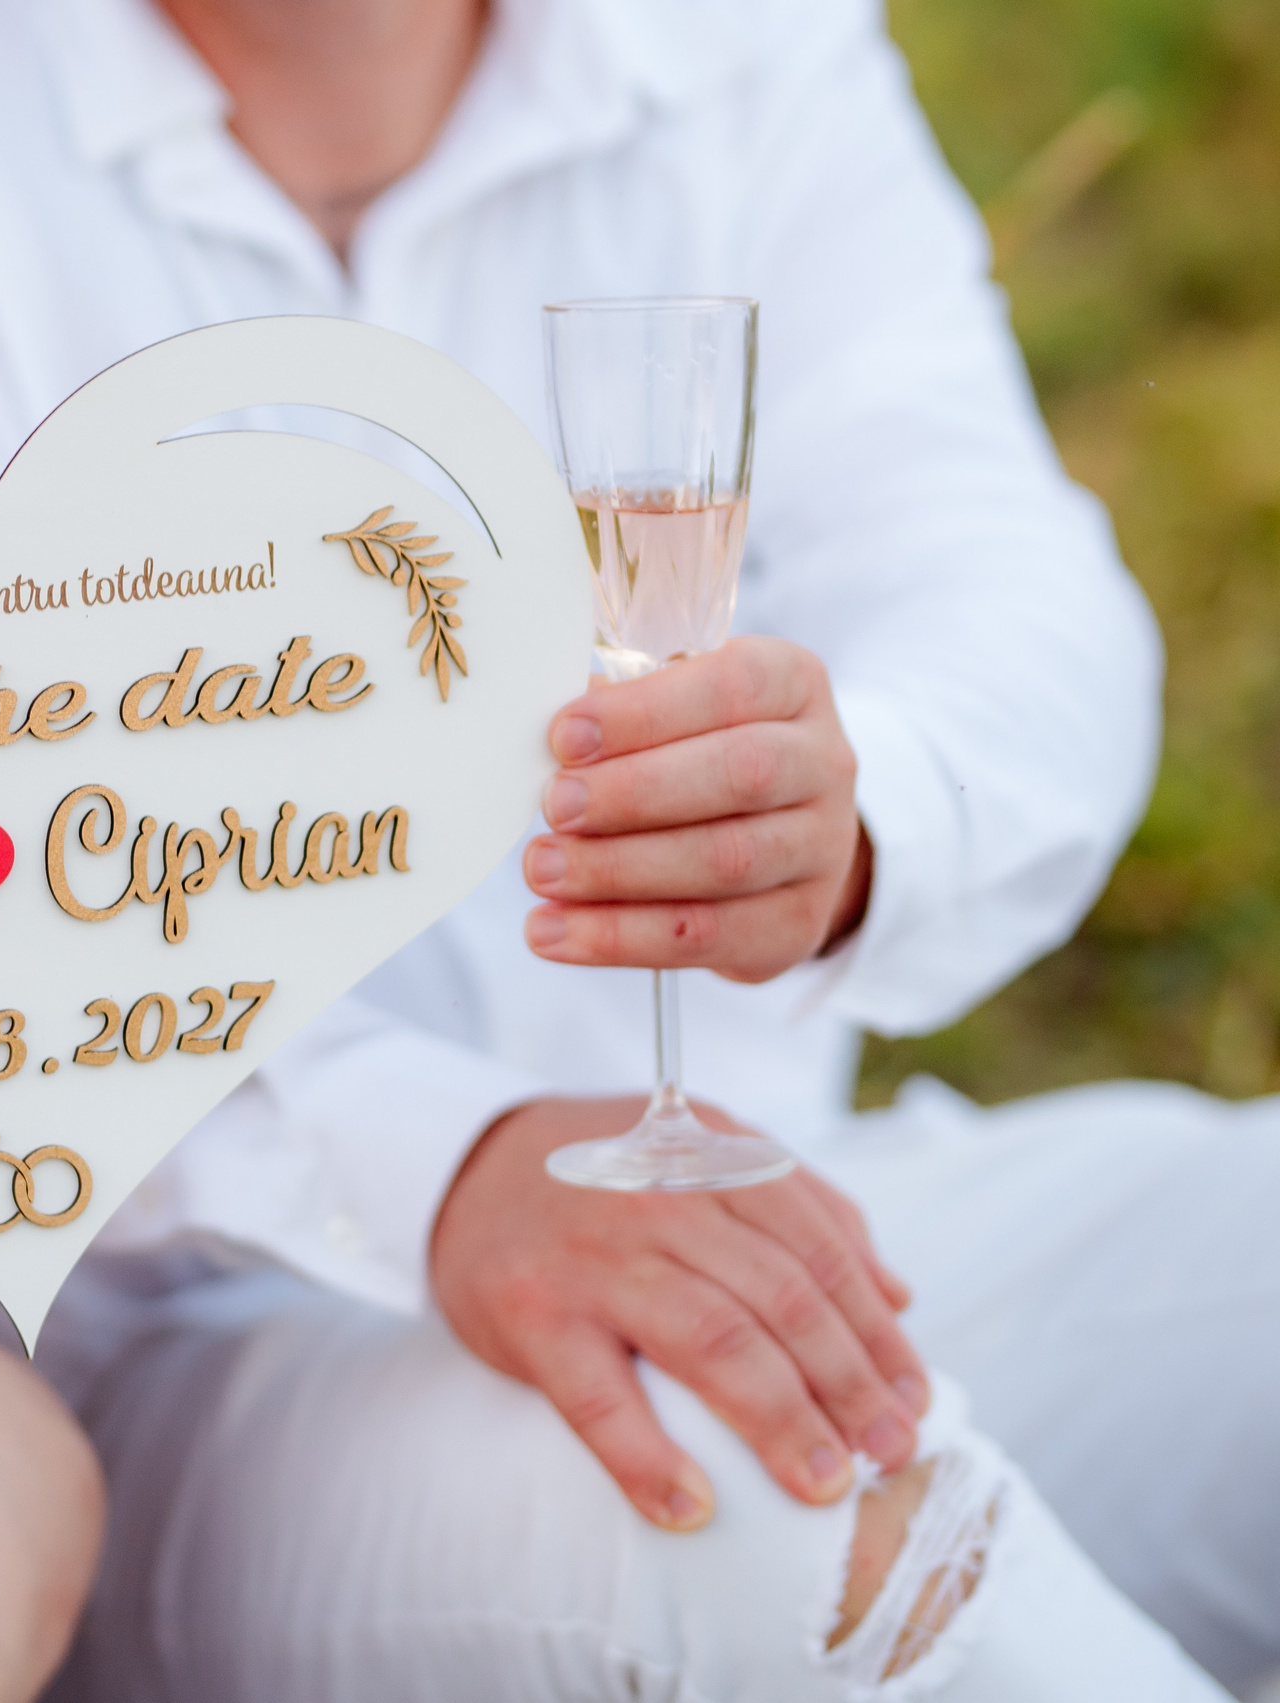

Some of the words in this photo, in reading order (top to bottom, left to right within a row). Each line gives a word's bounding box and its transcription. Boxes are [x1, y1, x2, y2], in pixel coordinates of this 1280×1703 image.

[79, 542, 277, 606] totdeauna!
[119, 635, 375, 733] date
[45, 785, 411, 945] Ciprian
